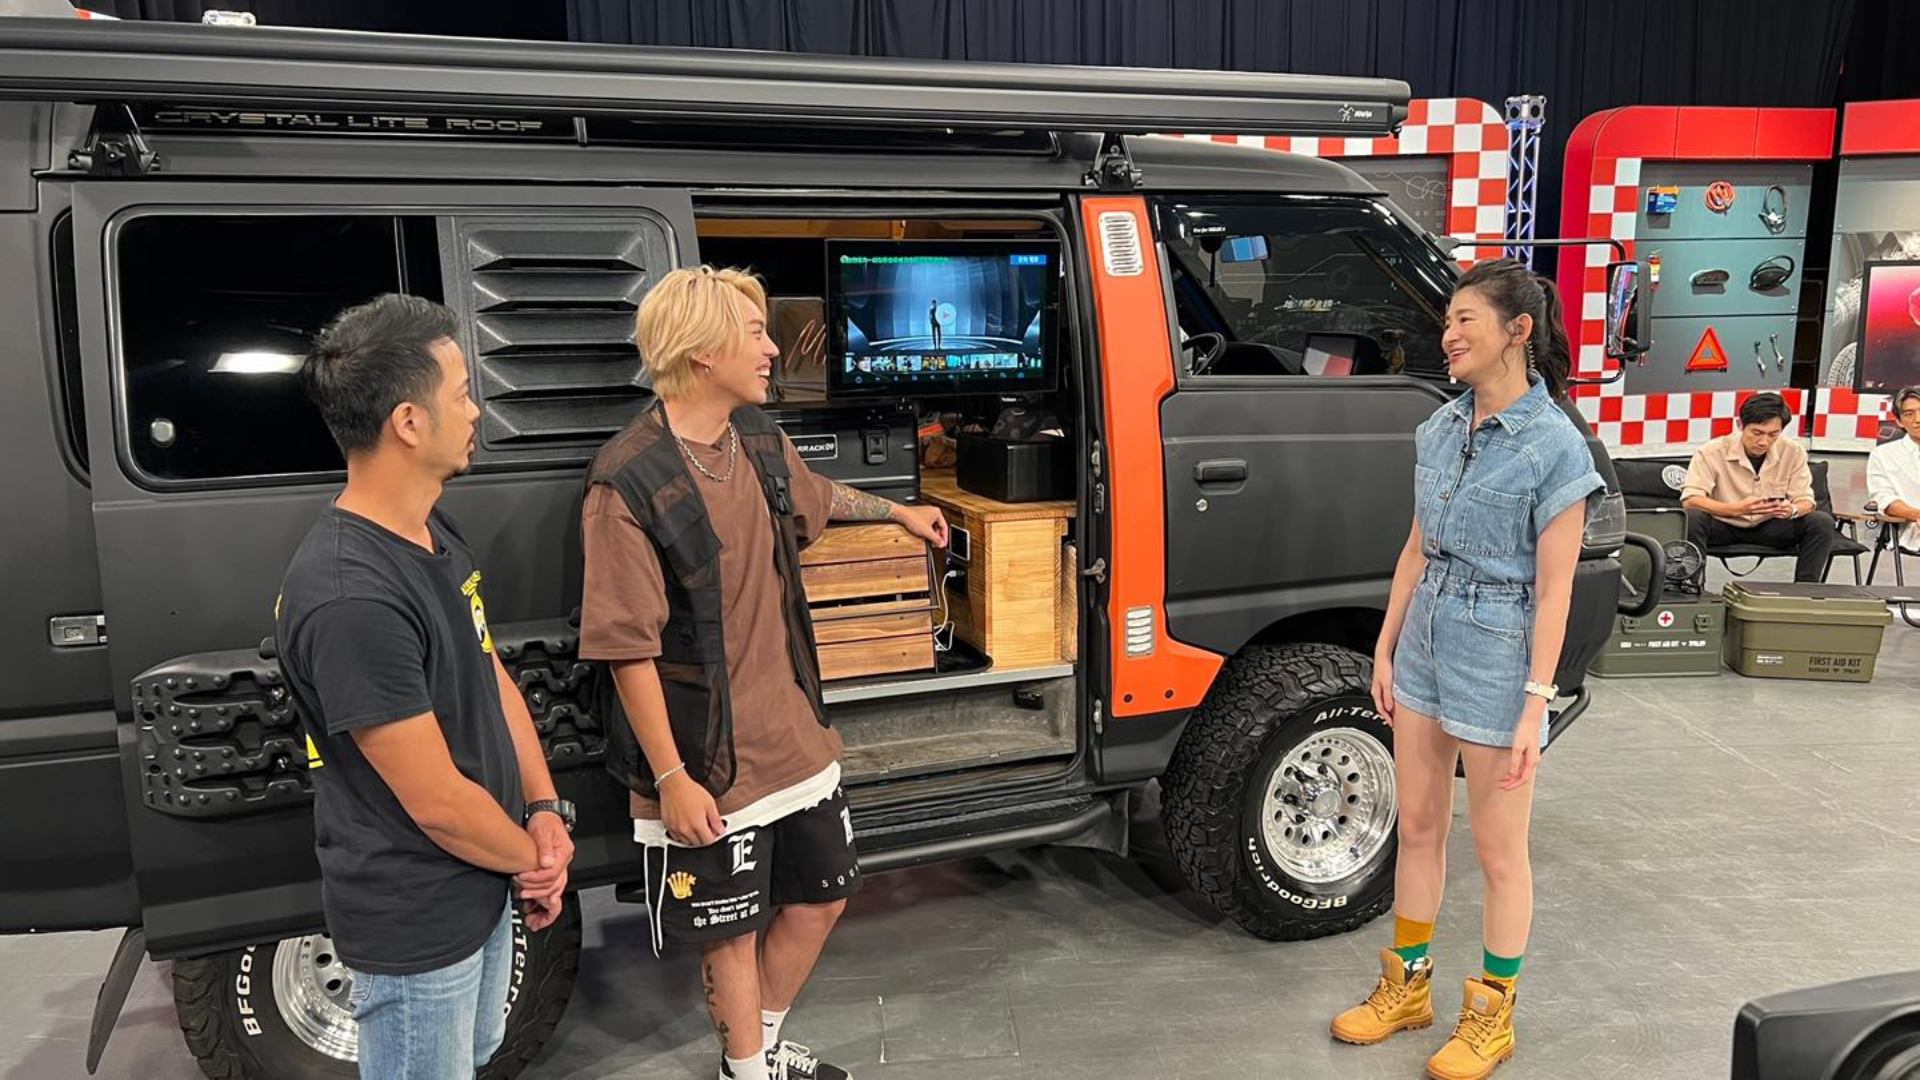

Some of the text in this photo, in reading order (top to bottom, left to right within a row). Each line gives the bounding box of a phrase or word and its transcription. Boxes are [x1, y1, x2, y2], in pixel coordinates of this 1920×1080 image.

[154, 111, 543, 132] CRYSTAL LITE ROOF
[1808, 656, 1862, 668] FIRST AID KIT
[727, 831, 757, 876] E
[1248, 837, 1349, 910] BFGoodrich
[710, 911, 738, 925] Street
